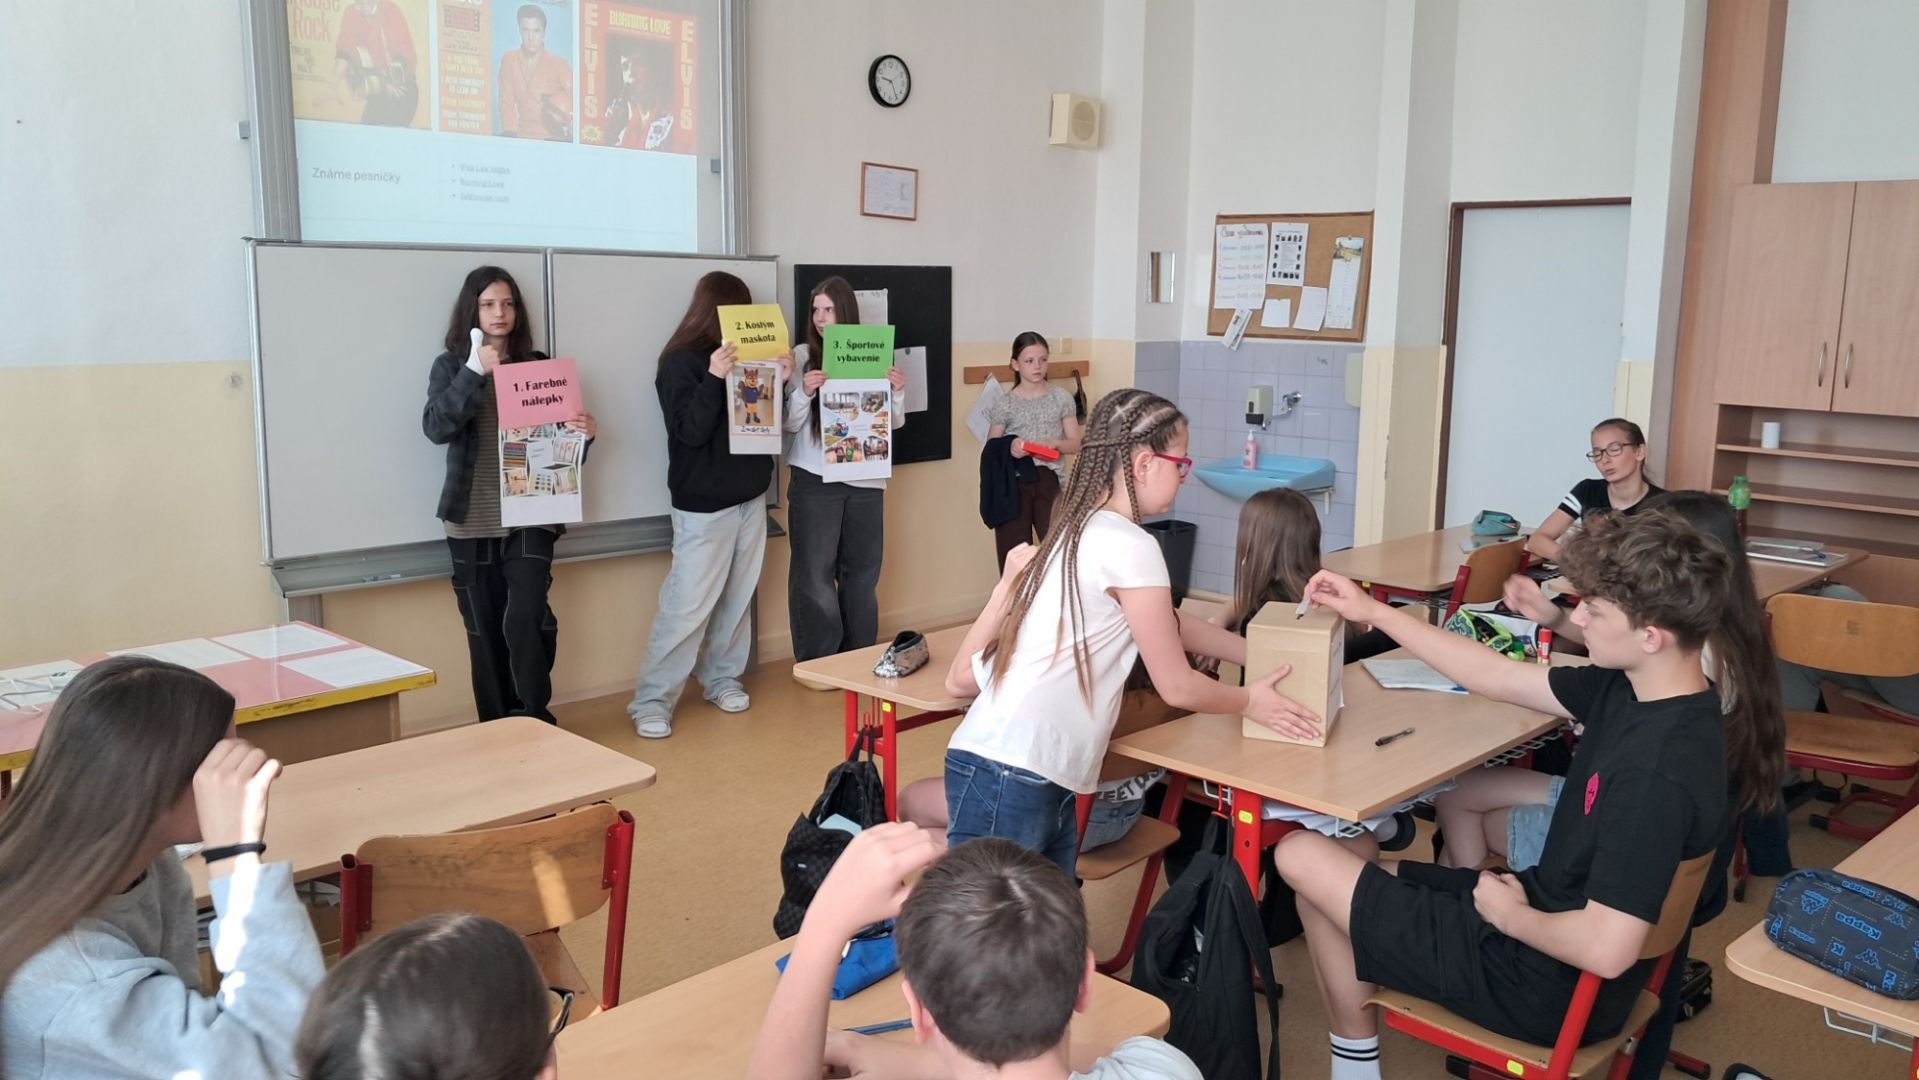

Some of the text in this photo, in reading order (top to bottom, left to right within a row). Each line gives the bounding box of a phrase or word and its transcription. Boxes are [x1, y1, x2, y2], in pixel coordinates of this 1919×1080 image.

[292, 8, 331, 42] Rock
[650, 17, 671, 35] LOVE
[583, 2, 598, 118] ELVIS
[680, 19, 694, 130] ELVIS
[311, 167, 401, 184] Známe pesničky
[735, 319, 775, 331] 2. Kostým
[740, 333, 777, 345] maskota
[832, 338, 885, 351] 3. Športové
[836, 353, 881, 364] vybavenie
[513, 376, 568, 392] 1. Farebné
[521, 393, 565, 407] nálepky
[1841, 880, 1877, 898] Kappa
[1835, 911, 1882, 940] Kappa
